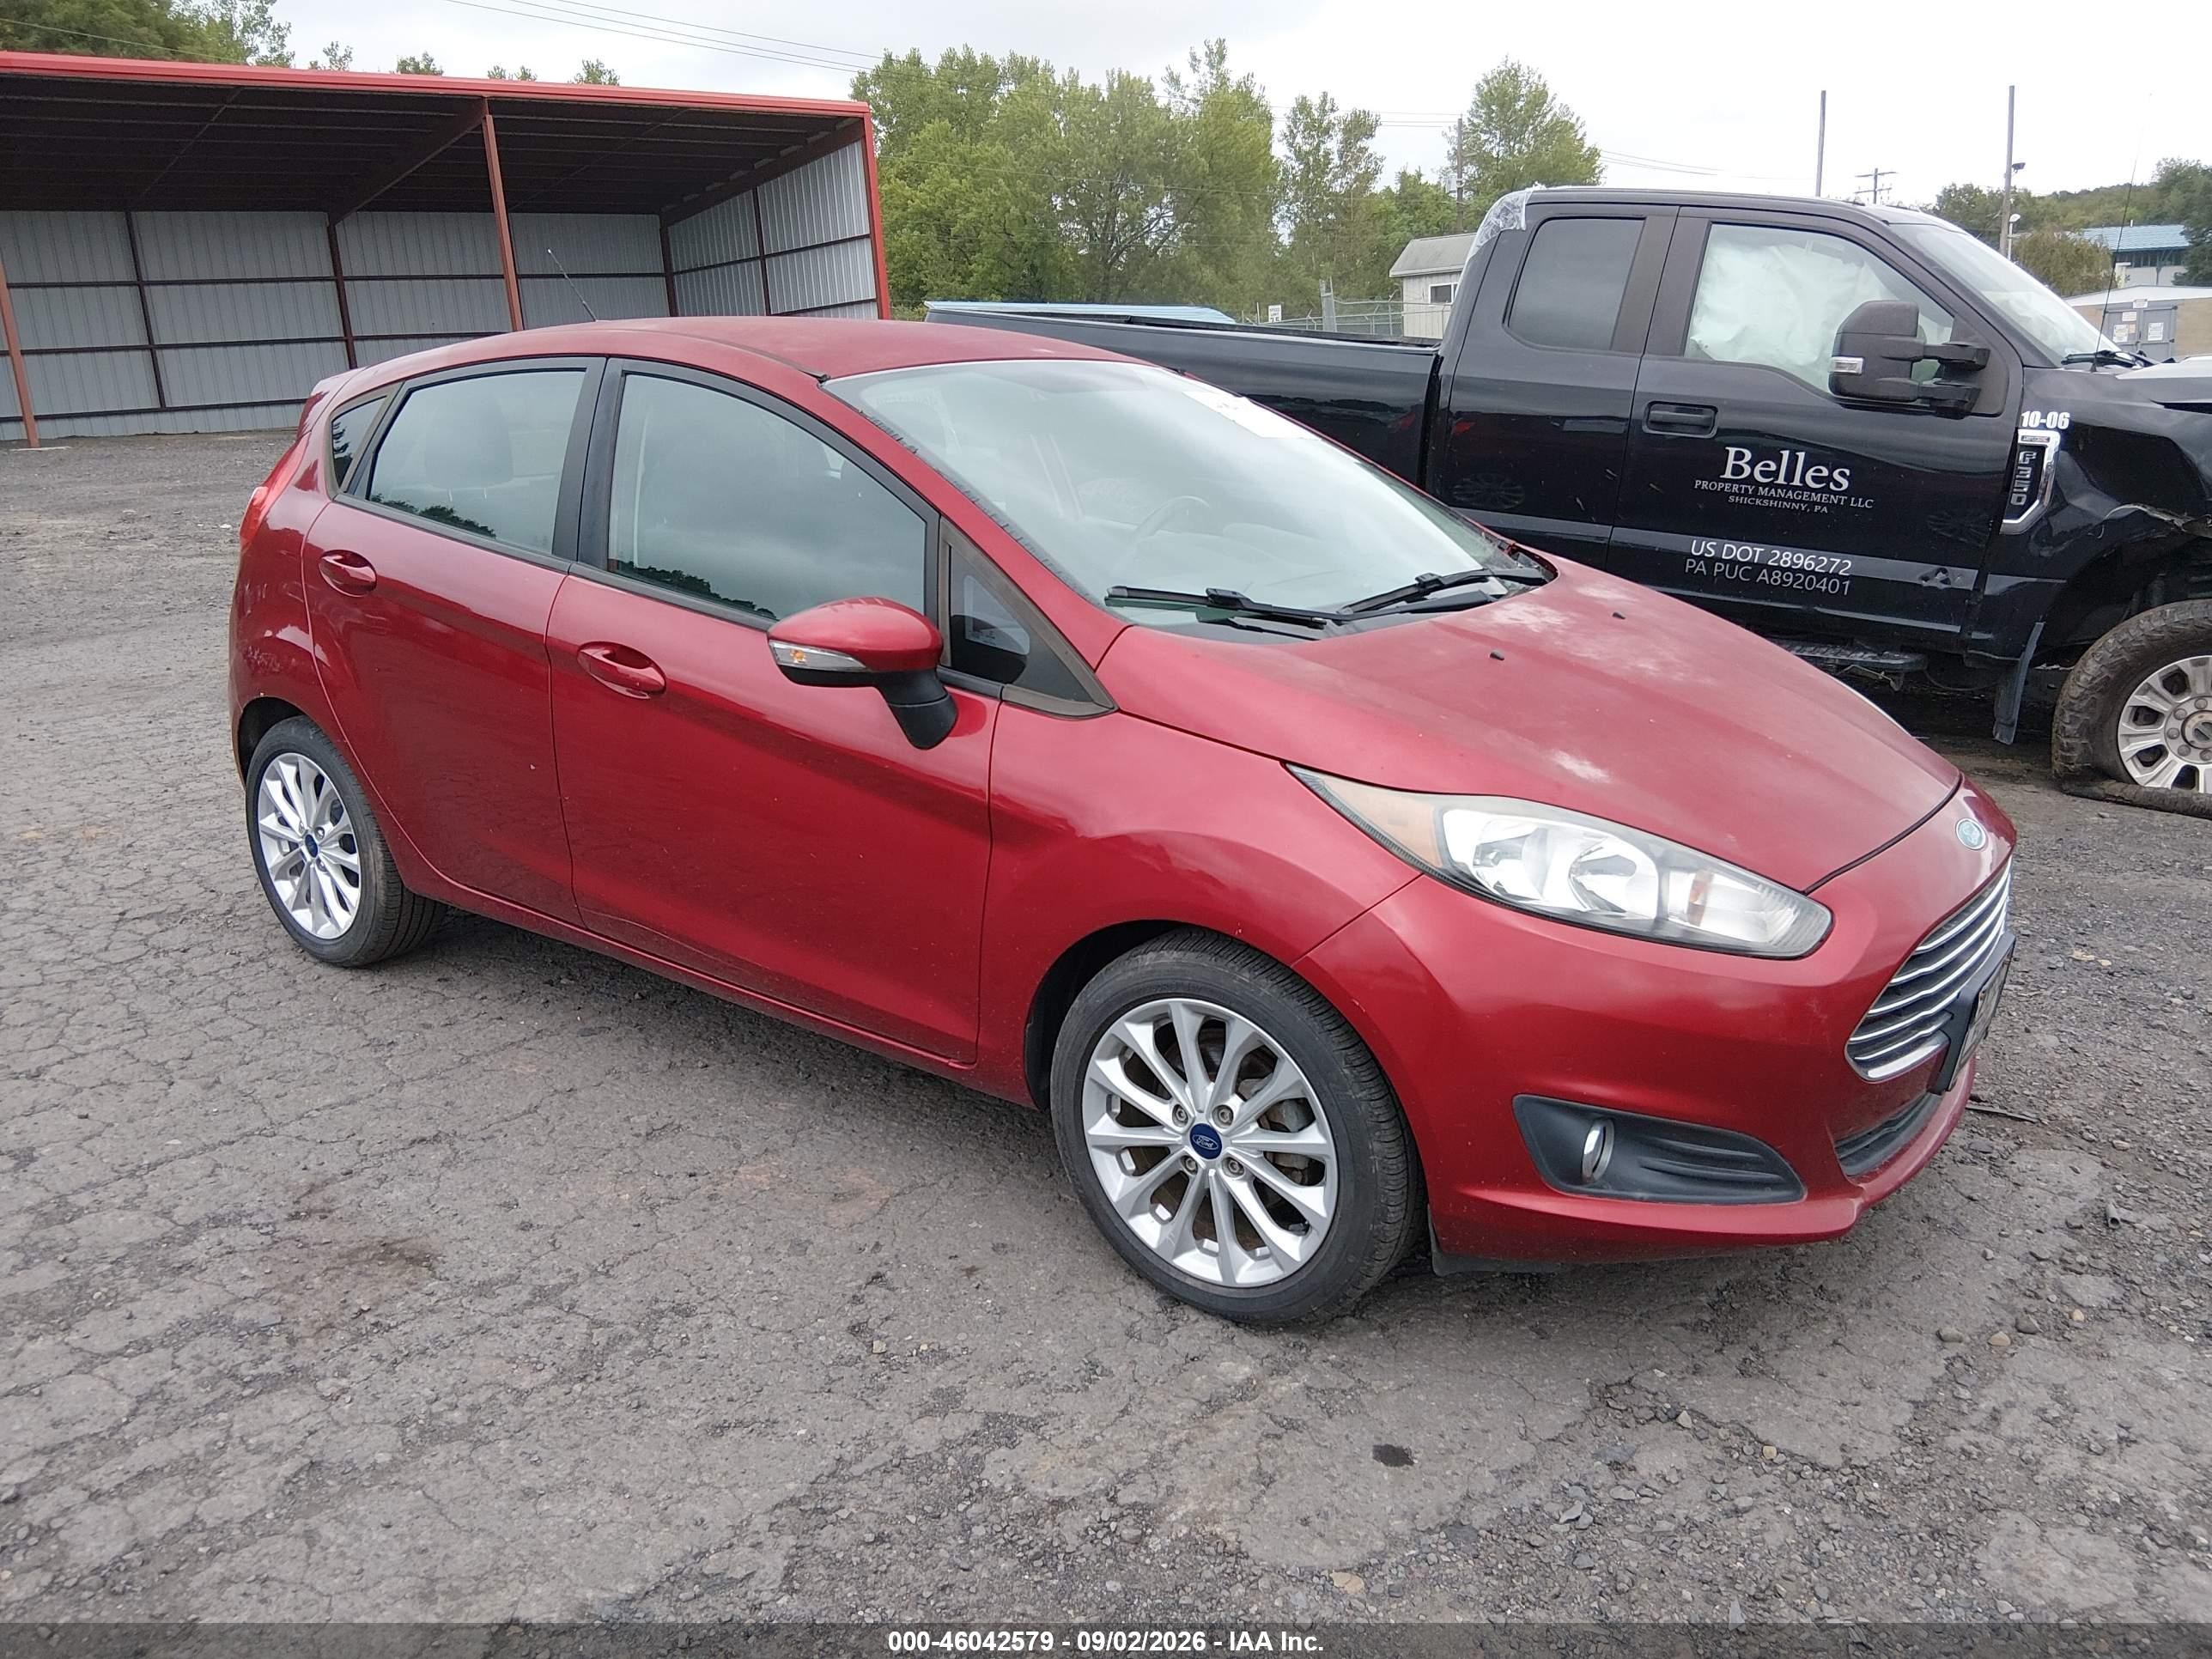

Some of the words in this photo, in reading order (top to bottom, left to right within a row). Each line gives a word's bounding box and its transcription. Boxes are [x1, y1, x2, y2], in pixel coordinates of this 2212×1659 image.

[2021, 410, 2070, 429] 10-06
[1719, 446, 1850, 491] Belles
[1694, 479, 1755, 495] PROPERTY
[1758, 486, 1847, 505] MANAGEMENT
[1850, 497, 1875, 508] LLC
[1728, 495, 1810, 513] SHICKSHINNY,
[1814, 505, 1828, 514] PA
[1691, 539, 1717, 557] US
[1722, 544, 1765, 563] DOT
[1767, 550, 1852, 576] 2896272
[1685, 558, 1707, 575] PA
[1713, 562, 1753, 581] PUC
[1756, 568, 1850, 596] A8920401
[1194, 1135, 1215, 1149] Ford
